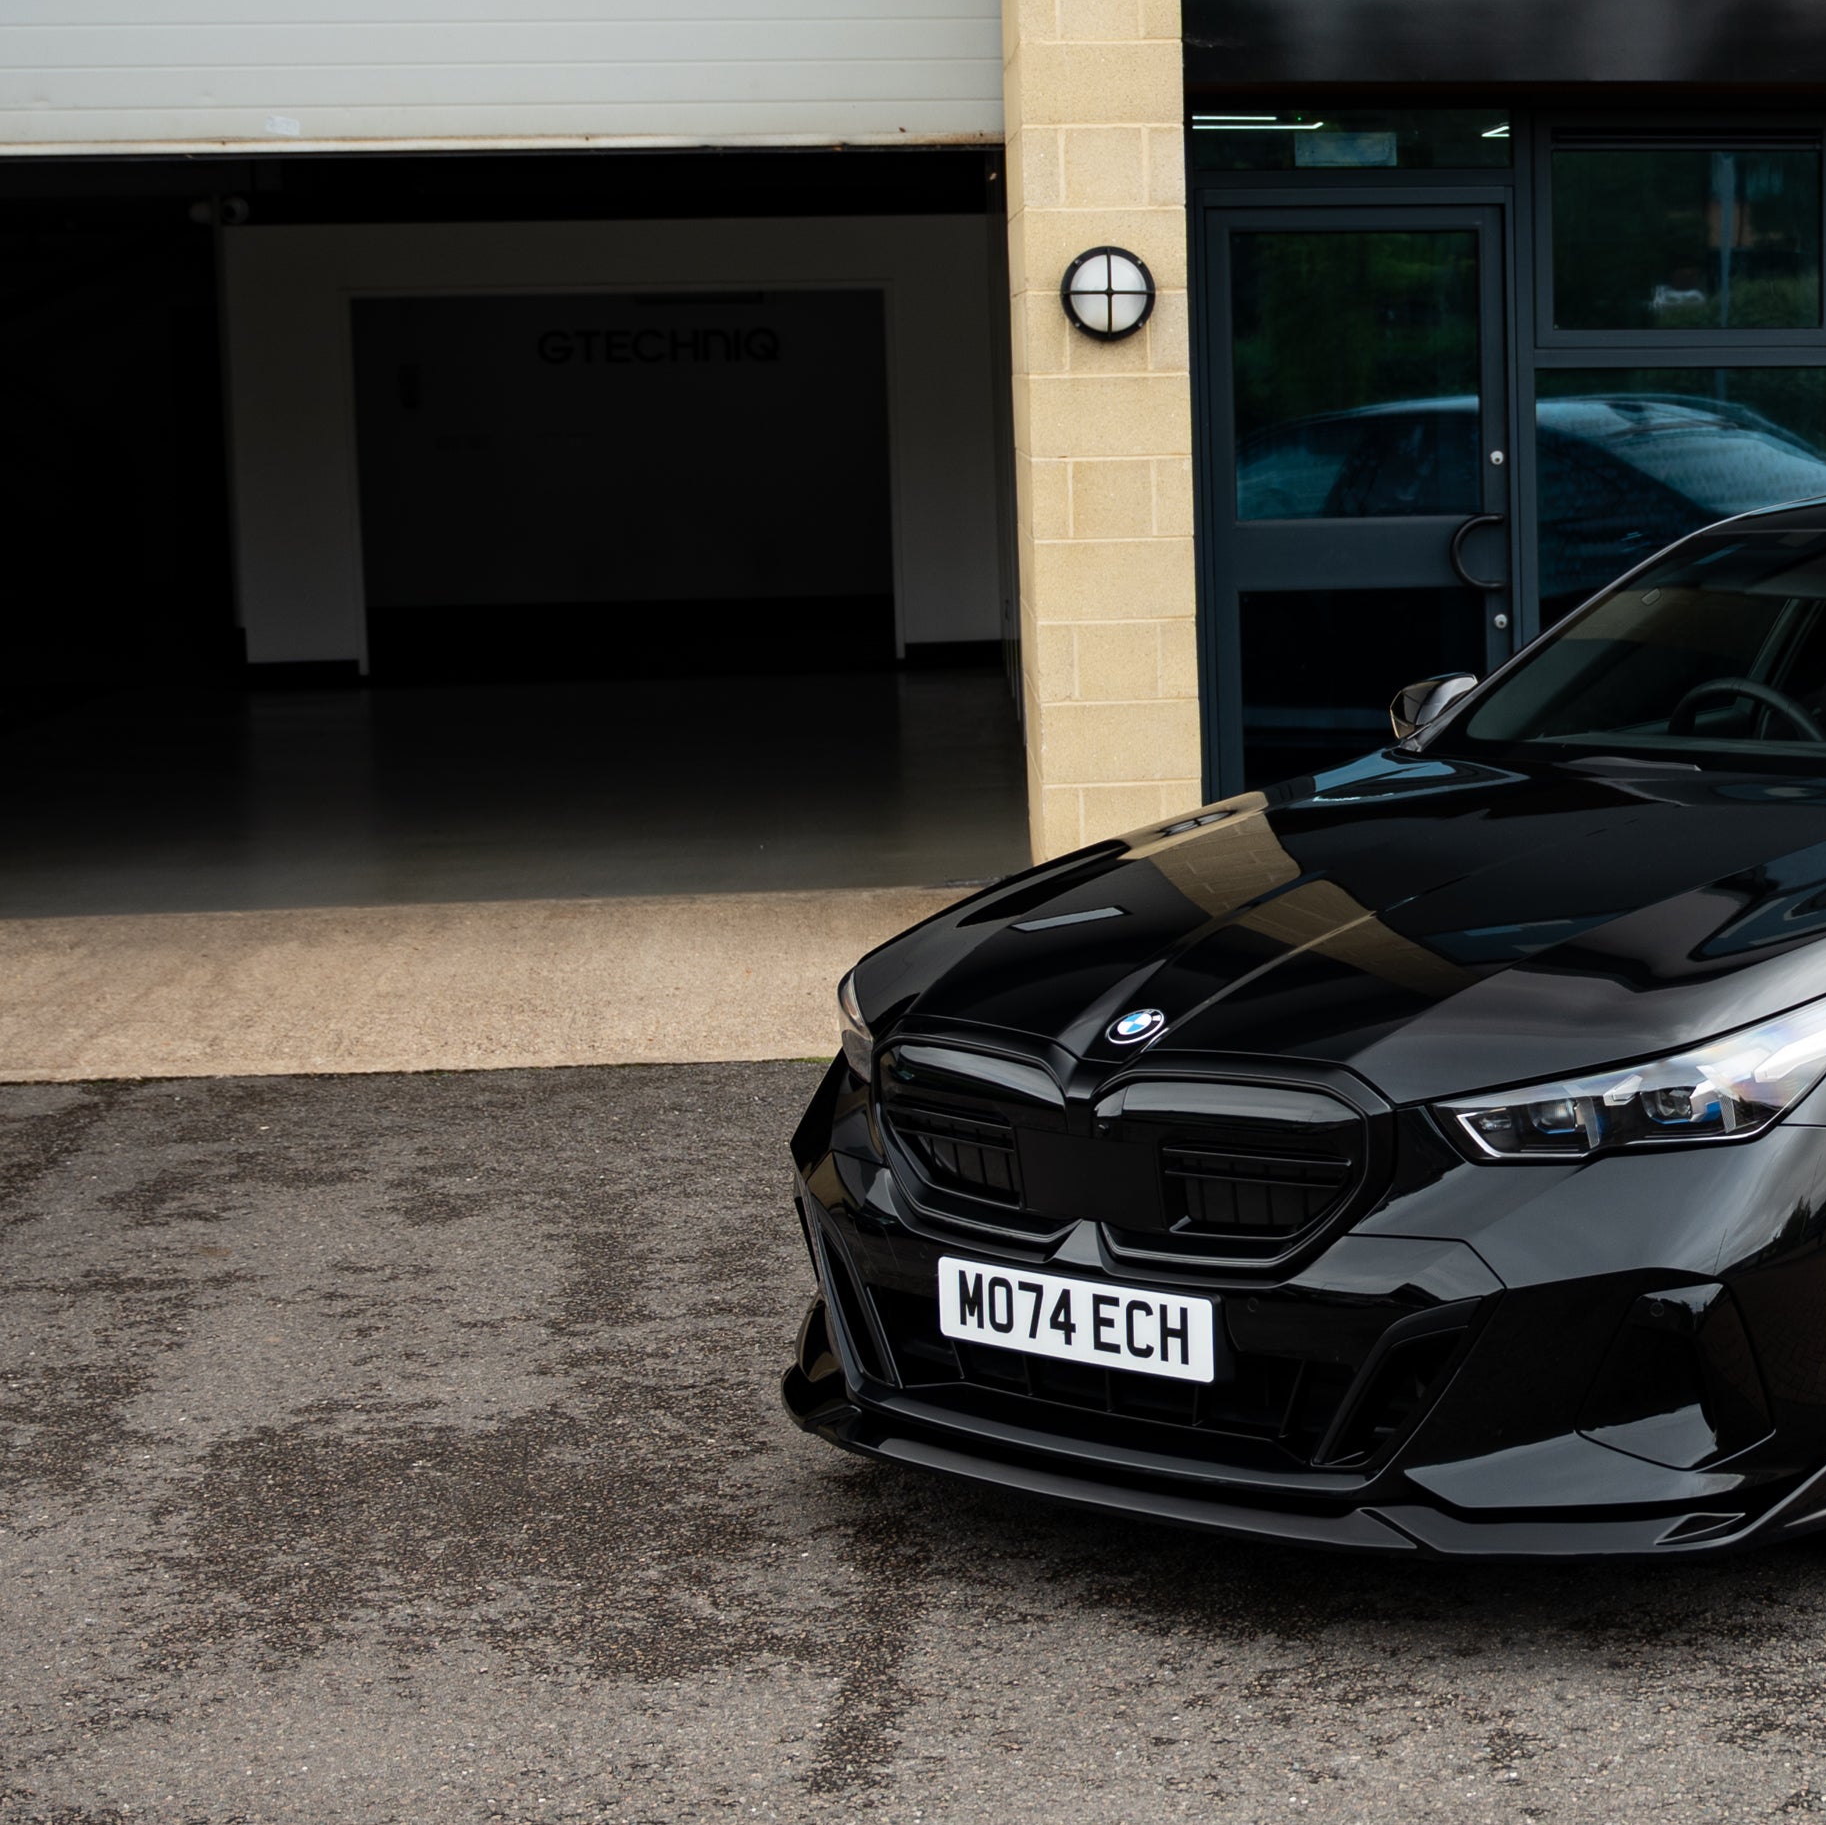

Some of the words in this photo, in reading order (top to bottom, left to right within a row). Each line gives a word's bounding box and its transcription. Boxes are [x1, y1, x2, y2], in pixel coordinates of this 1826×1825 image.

[538, 326, 780, 365] GTECHNIQ
[958, 1269, 1077, 1346] MO74
[1092, 1293, 1190, 1365] ECH
